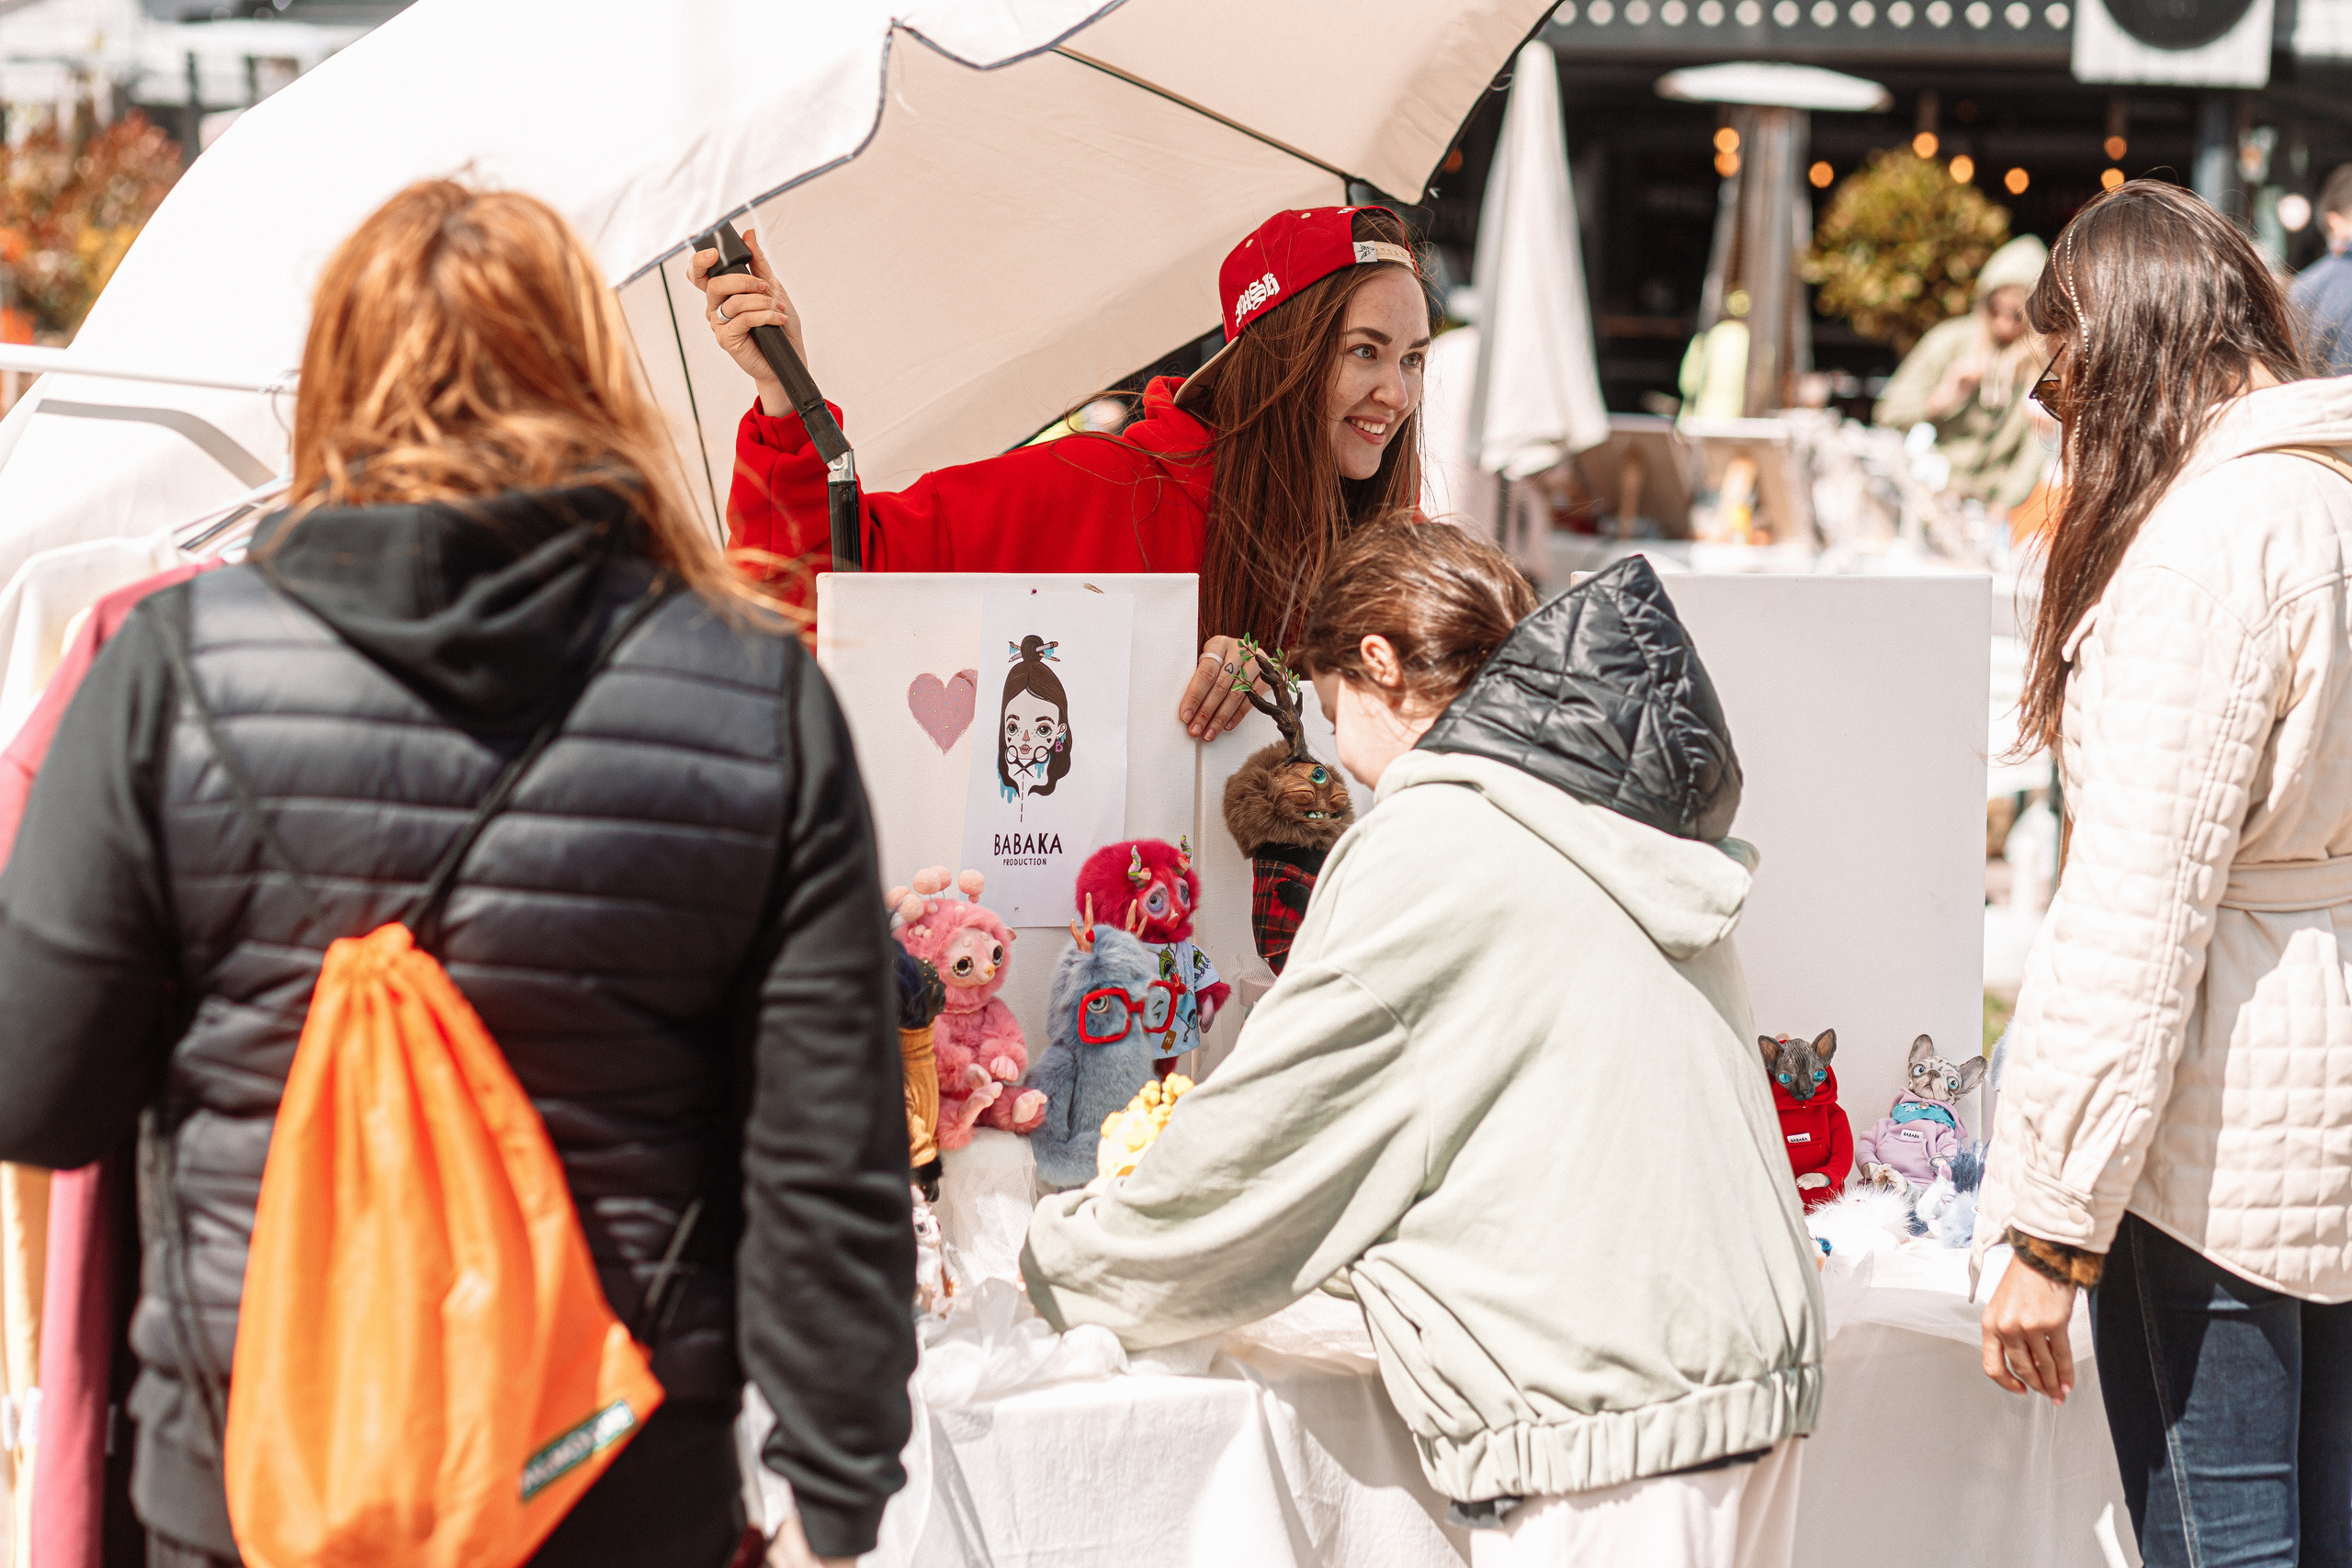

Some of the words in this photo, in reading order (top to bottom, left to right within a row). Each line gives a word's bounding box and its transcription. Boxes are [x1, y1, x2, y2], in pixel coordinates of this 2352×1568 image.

[993, 832, 1063, 856] BABAKA
[1002, 858, 1047, 866] PRODUCTION
[1164, 1035, 1173, 1044] Hi
